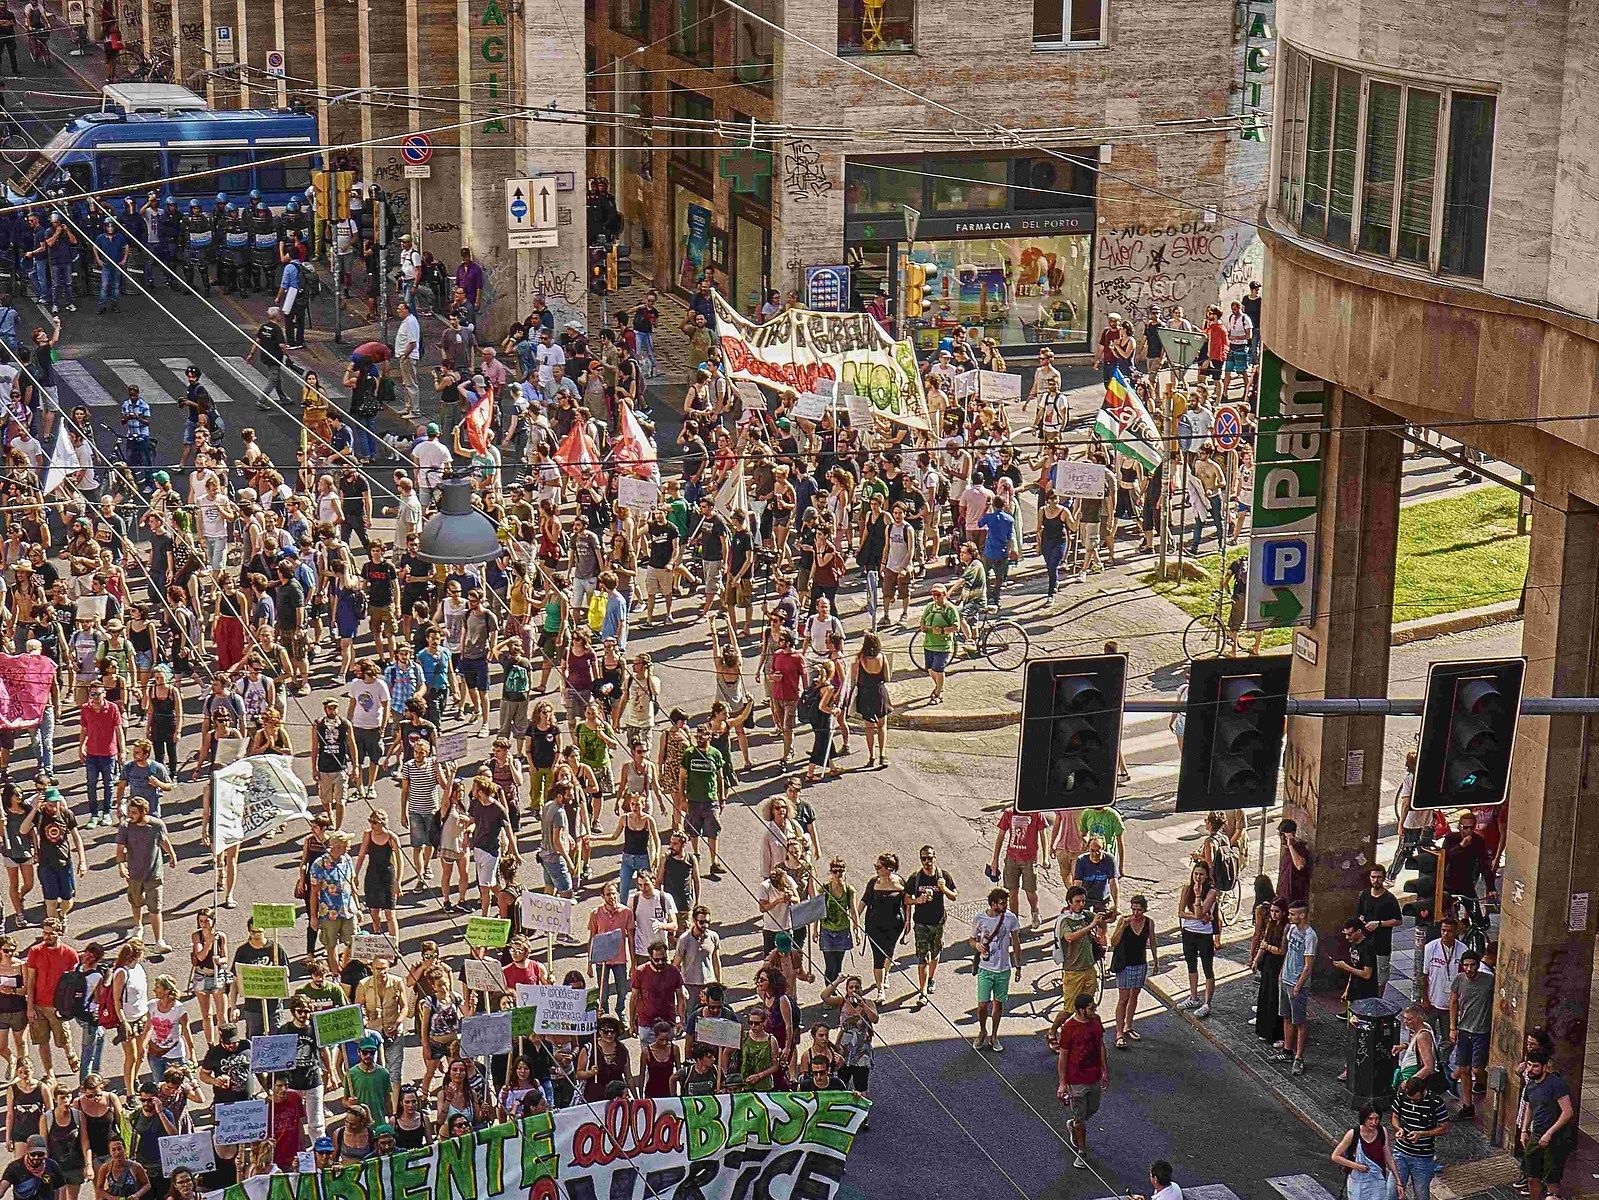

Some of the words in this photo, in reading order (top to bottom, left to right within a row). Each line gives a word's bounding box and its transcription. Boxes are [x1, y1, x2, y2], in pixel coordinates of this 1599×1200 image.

[1240, 0, 1272, 142] ACIA
[956, 221, 1012, 232] FARMACIA
[1022, 220, 1041, 229] DEL
[1044, 219, 1079, 228] PORTO
[1274, 547, 1302, 581] P
[529, 898, 543, 909] NO
[545, 901, 563, 914] OIL
[531, 914, 544, 923] NO
[571, 1098, 686, 1169] alla
[681, 1090, 872, 1162] BASE
